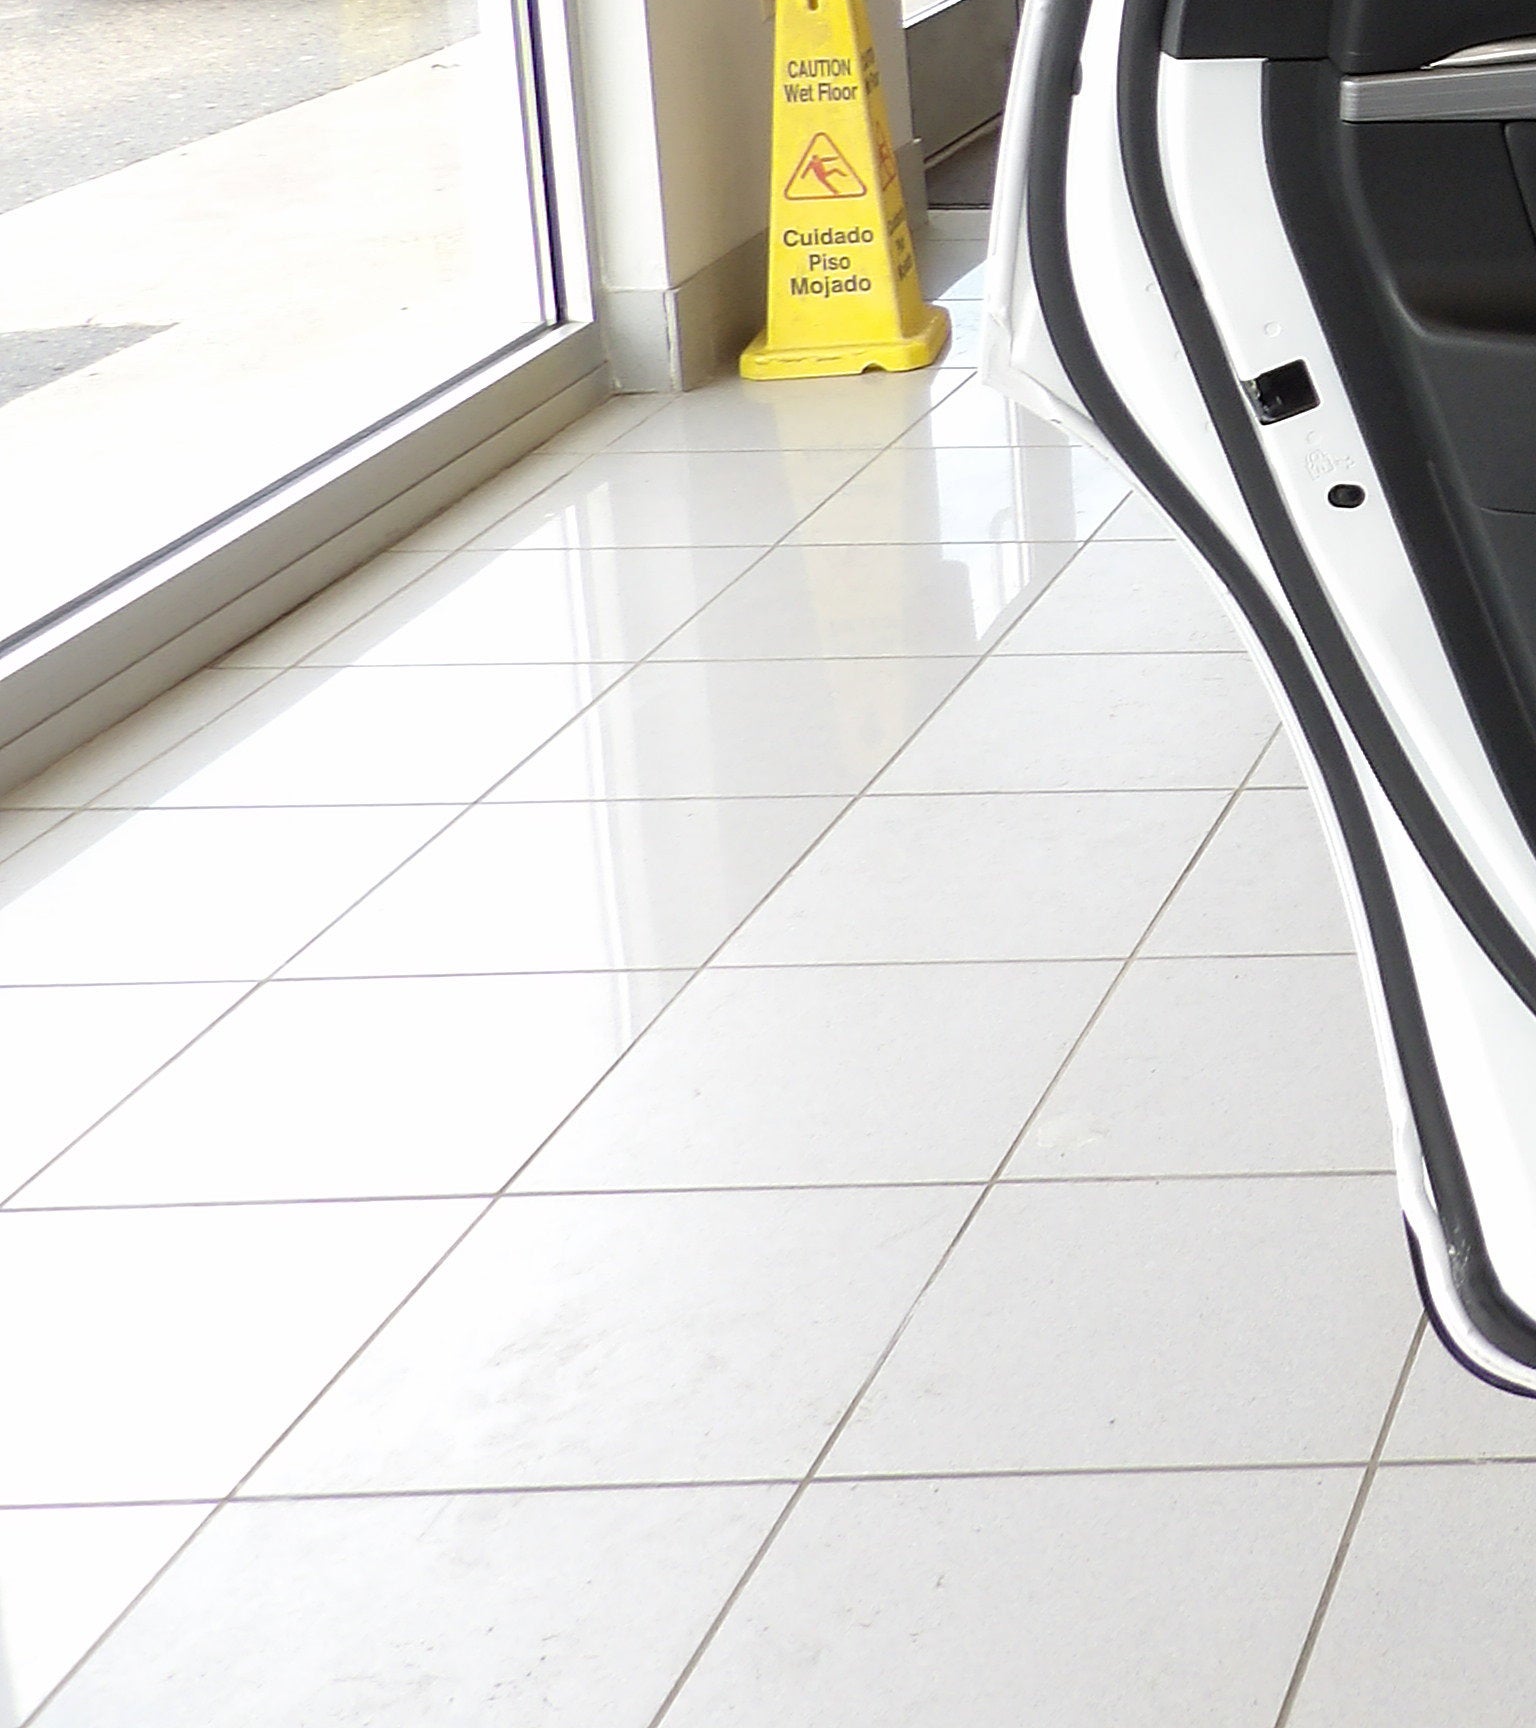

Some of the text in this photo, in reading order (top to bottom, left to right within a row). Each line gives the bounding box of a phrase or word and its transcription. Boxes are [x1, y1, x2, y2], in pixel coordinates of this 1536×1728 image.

[788, 58, 851, 78] CAUTION
[784, 82, 858, 102] Wet Floor
[783, 226, 874, 247] Cuidado
[809, 253, 851, 271] Piso
[790, 275, 871, 298] Mojado
